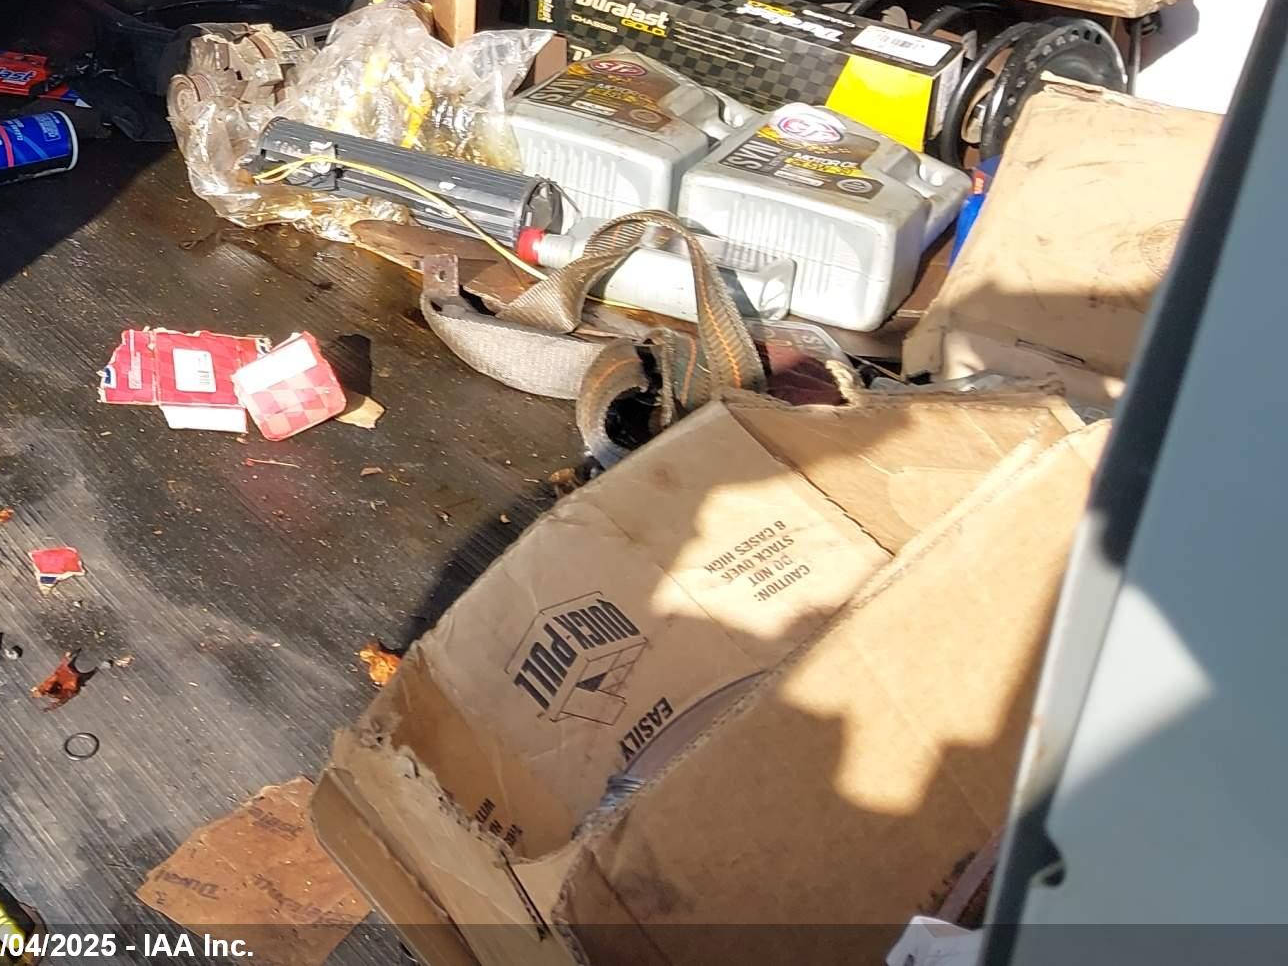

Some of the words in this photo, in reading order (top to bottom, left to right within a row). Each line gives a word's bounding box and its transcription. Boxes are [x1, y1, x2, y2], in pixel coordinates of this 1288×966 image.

[570, 14, 619, 34] CHASSIS
[725, 140, 783, 170] SYN
[734, 527, 776, 556] CASES
[753, 535, 795, 562] STACK
[704, 551, 737, 574] HIGH
[721, 559, 756, 583] OVER
[747, 566, 775, 587] NOT
[753, 564, 811, 601] CAUTION:
[619, 697, 674, 762] EASILY
